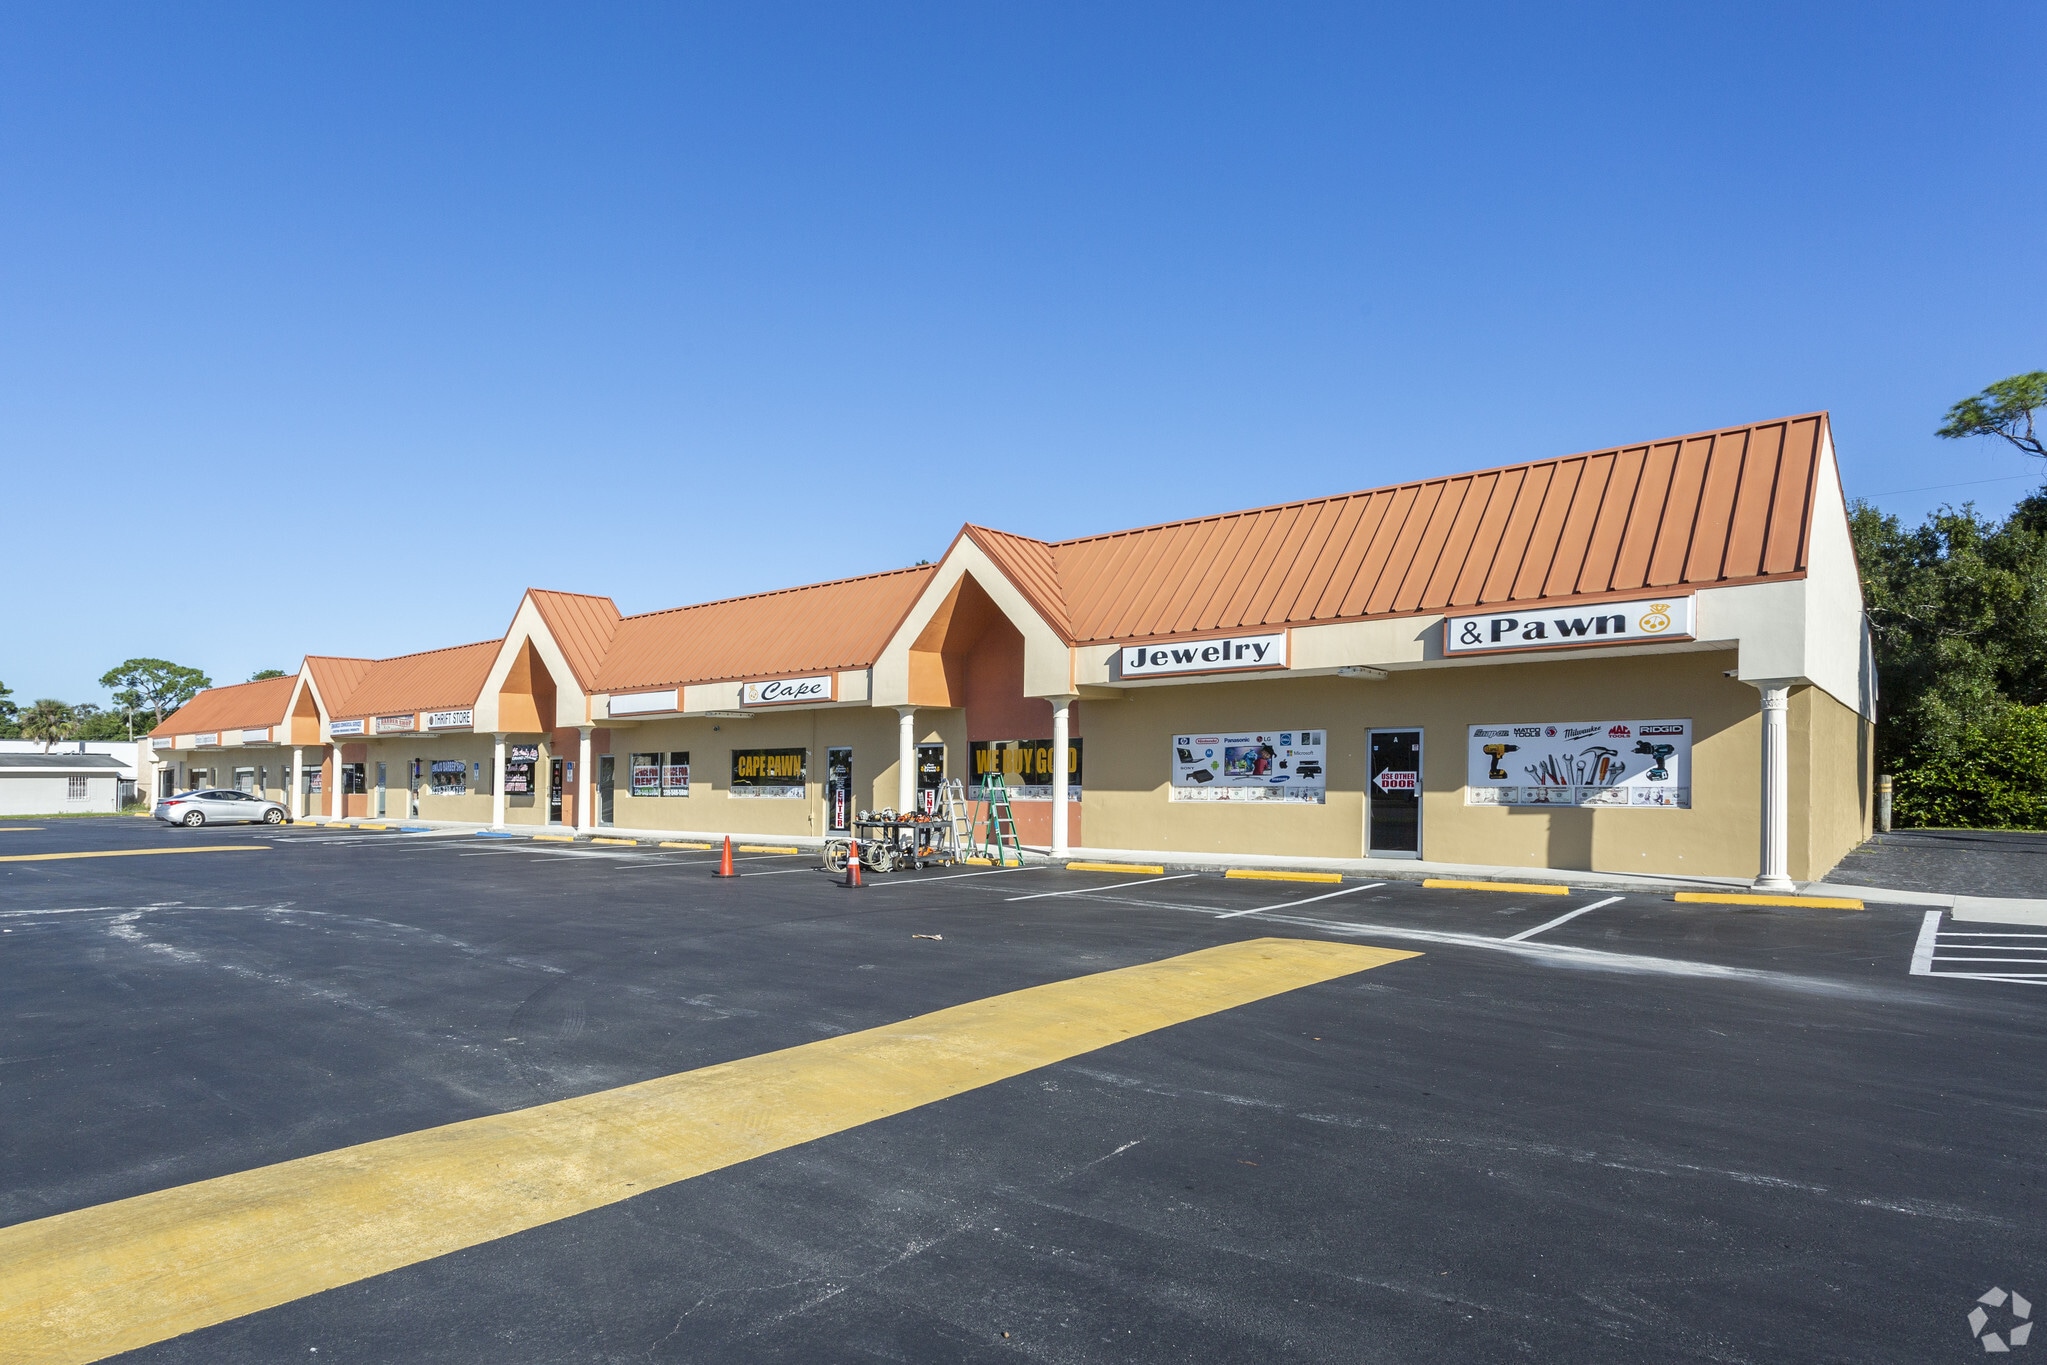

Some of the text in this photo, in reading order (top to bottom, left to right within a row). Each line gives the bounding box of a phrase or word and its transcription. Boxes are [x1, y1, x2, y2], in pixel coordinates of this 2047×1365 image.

[1460, 614, 1626, 644] & Pawn
[1130, 640, 1270, 668] Jewelry
[761, 682, 822, 700] Cape
[434, 711, 470, 725] THRIFT STORE
[1563, 726, 1602, 738] Milwaukee
[1608, 725, 1631, 734] MAC
[1640, 725, 1682, 733] RIDGID
[738, 755, 801, 777] CAPE PAWN
[976, 747, 1077, 774] WE BUY GOD
[634, 777, 658, 785] RENT
[663, 777, 688, 785] RENT
[1381, 780, 1415, 788] DOOR
